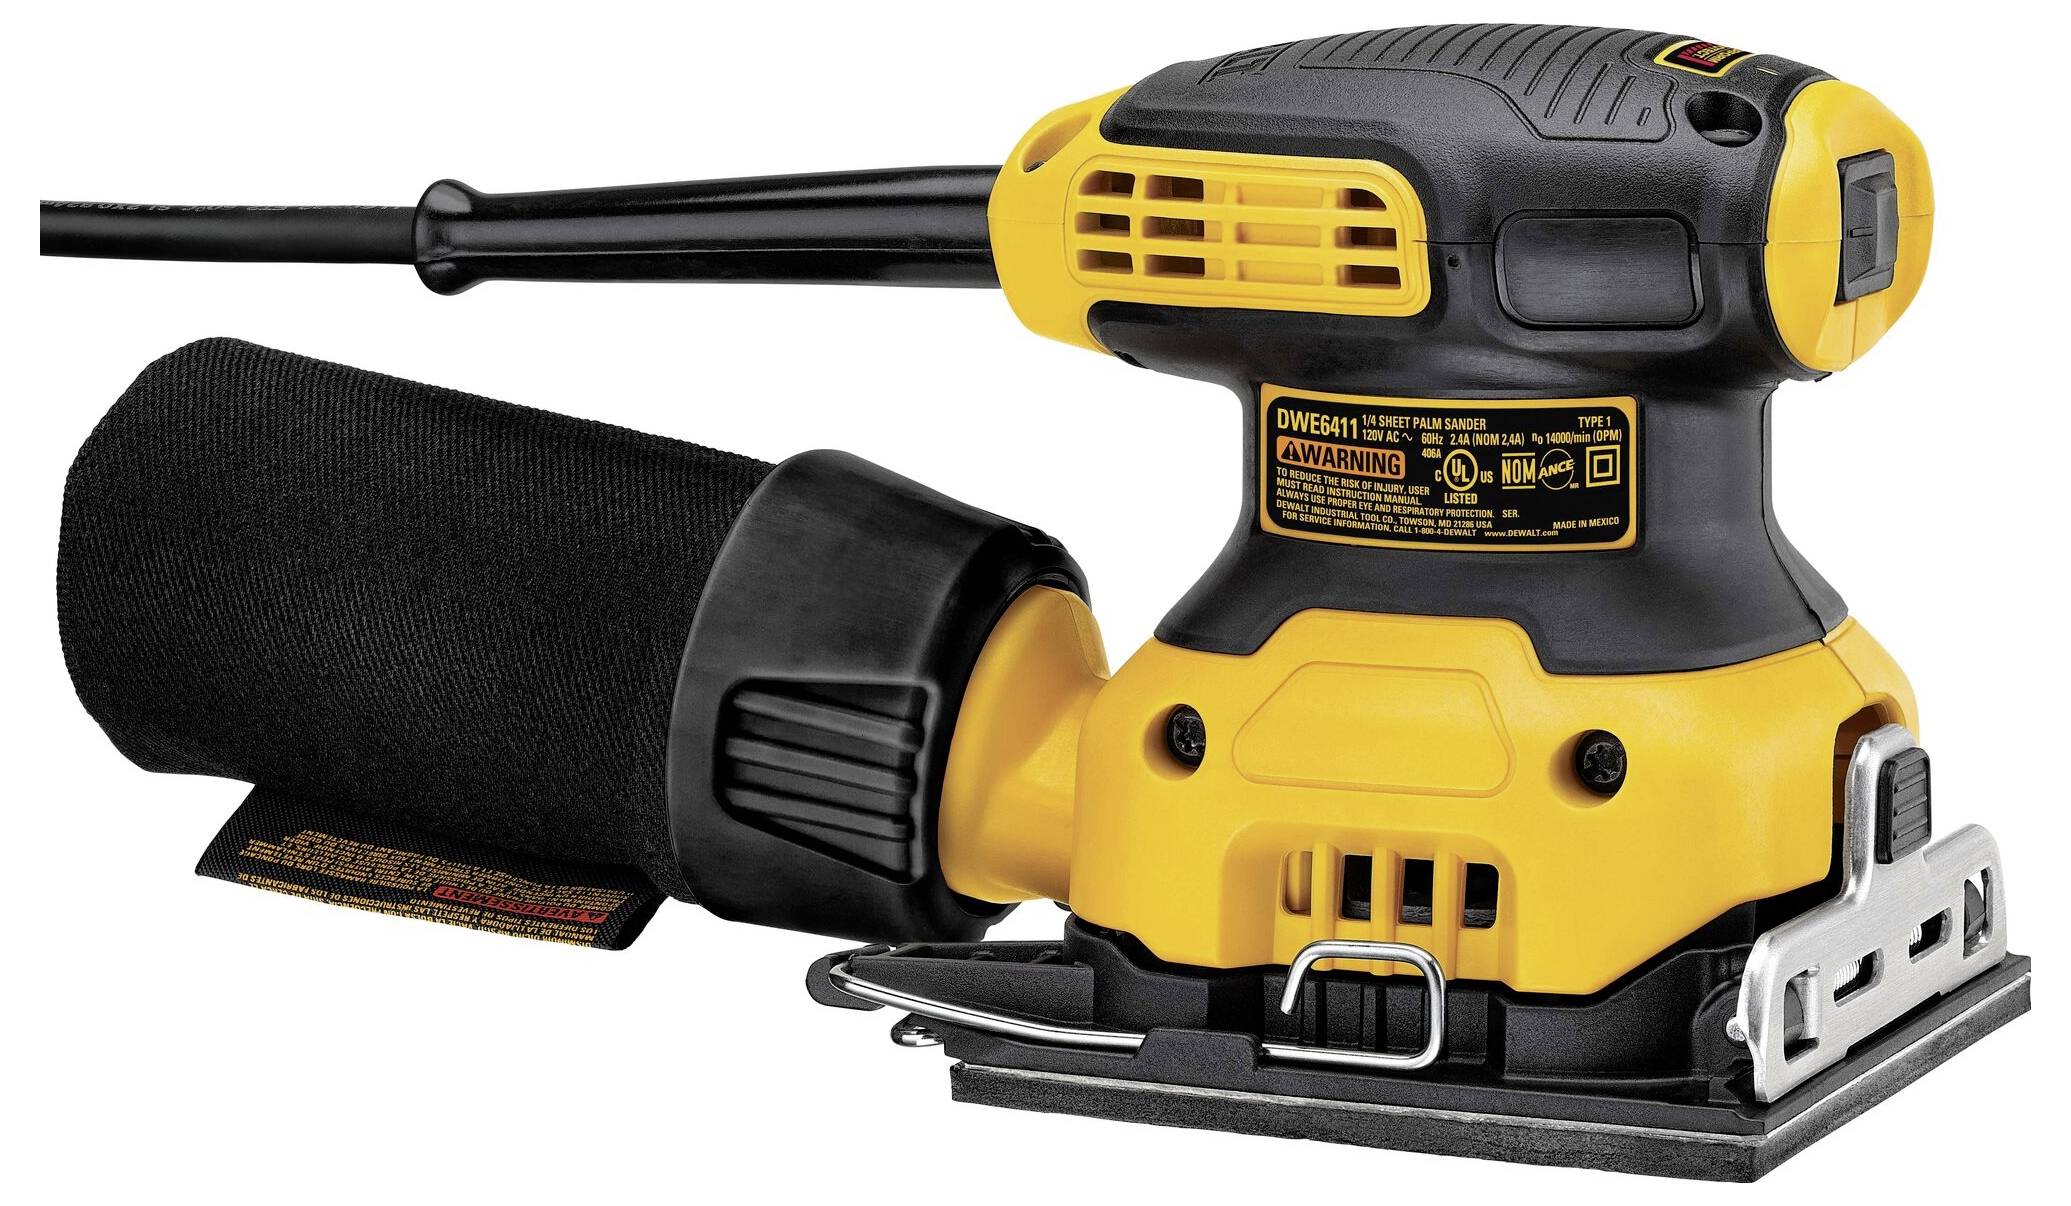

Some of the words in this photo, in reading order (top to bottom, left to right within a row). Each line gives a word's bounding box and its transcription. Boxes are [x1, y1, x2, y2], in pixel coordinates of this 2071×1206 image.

[1277, 408, 1358, 439] DWE6411
[1362, 414, 1376, 427] 1/4
[1379, 415, 1410, 428] SHEET
[1413, 417, 1442, 430] PALM
[1445, 418, 1486, 430] SANDER
[1578, 416, 1604, 428] TYPE
[1606, 416, 1610, 426] 1
[1362, 430, 1383, 442] 120V
[1386, 430, 1400, 442] AC
[1422, 433, 1443, 444] 60Hz
[1450, 433, 1470, 445] 2.4A
[1473, 433, 1499, 447] (NOM
[1502, 432, 1524, 447] 2,4A)
[1546, 431, 1590, 444] 14000/min
[1593, 429, 1622, 444] (OPM)
[1300, 443, 1400, 475] WARNING
[1422, 448, 1441, 458] 406A
[1480, 471, 1493, 483] US
[1502, 459, 1535, 483] NOM
[1538, 459, 1575, 479] ANCE
[1277, 467, 1287, 476] TO
[1290, 469, 1321, 483] REDUCE
[1324, 475, 1339, 486] THE
[1341, 478, 1360, 489] RISK
[1362, 481, 1372, 490] OF
[1374, 482, 1406, 495] INJURY,
[1409, 486, 1430, 496] USER
[1277, 478, 1300, 490] MUST
[1303, 482, 1324, 494] READ
[1327, 487, 1381, 501] INSTRUCTION
[1277, 488, 1309, 501] ALWAYS
[1311, 495, 1326, 504] USE
[1328, 497, 1357, 509] PROPER
[1359, 502, 1372, 511] EYE
[1374, 504, 1391, 513] AND
[1393, 506, 1444, 517] RESPIRATORY
[1446, 509, 1494, 518] PROTECTION.
[1444, 493, 1477, 504] LISTED
[1277, 500, 1309, 512] DEWALT
[1312, 506, 1358, 520] INDUSTRIAL
[1361, 513, 1380, 522] TOOL
[1399, 517, 1436, 528] TOWSON,
[1502, 510, 1519, 518] SER.
[1553, 520, 1576, 529] MADE
[1579, 520, 1587, 528] IN
[1589, 516, 1619, 527] MEXICO
[1283, 511, 1297, 520] FOR
[1300, 514, 1331, 526] SERVICE
[1415, 527, 1477, 536] 1-800-4-DEWALT
[1485, 529, 1558, 537] www.DEWALT.com
[249, 875, 309, 892] FABRICANTES
[342, 894, 411, 911] INSTRUCCIONES
[413, 905, 430, 914] LAS
[436, 887, 583, 920] AVERTISSEMENT
[431, 908, 470, 921] RESPETE
[480, 918, 524, 931] LIJADORA
[553, 930, 594, 941] MANUAL
